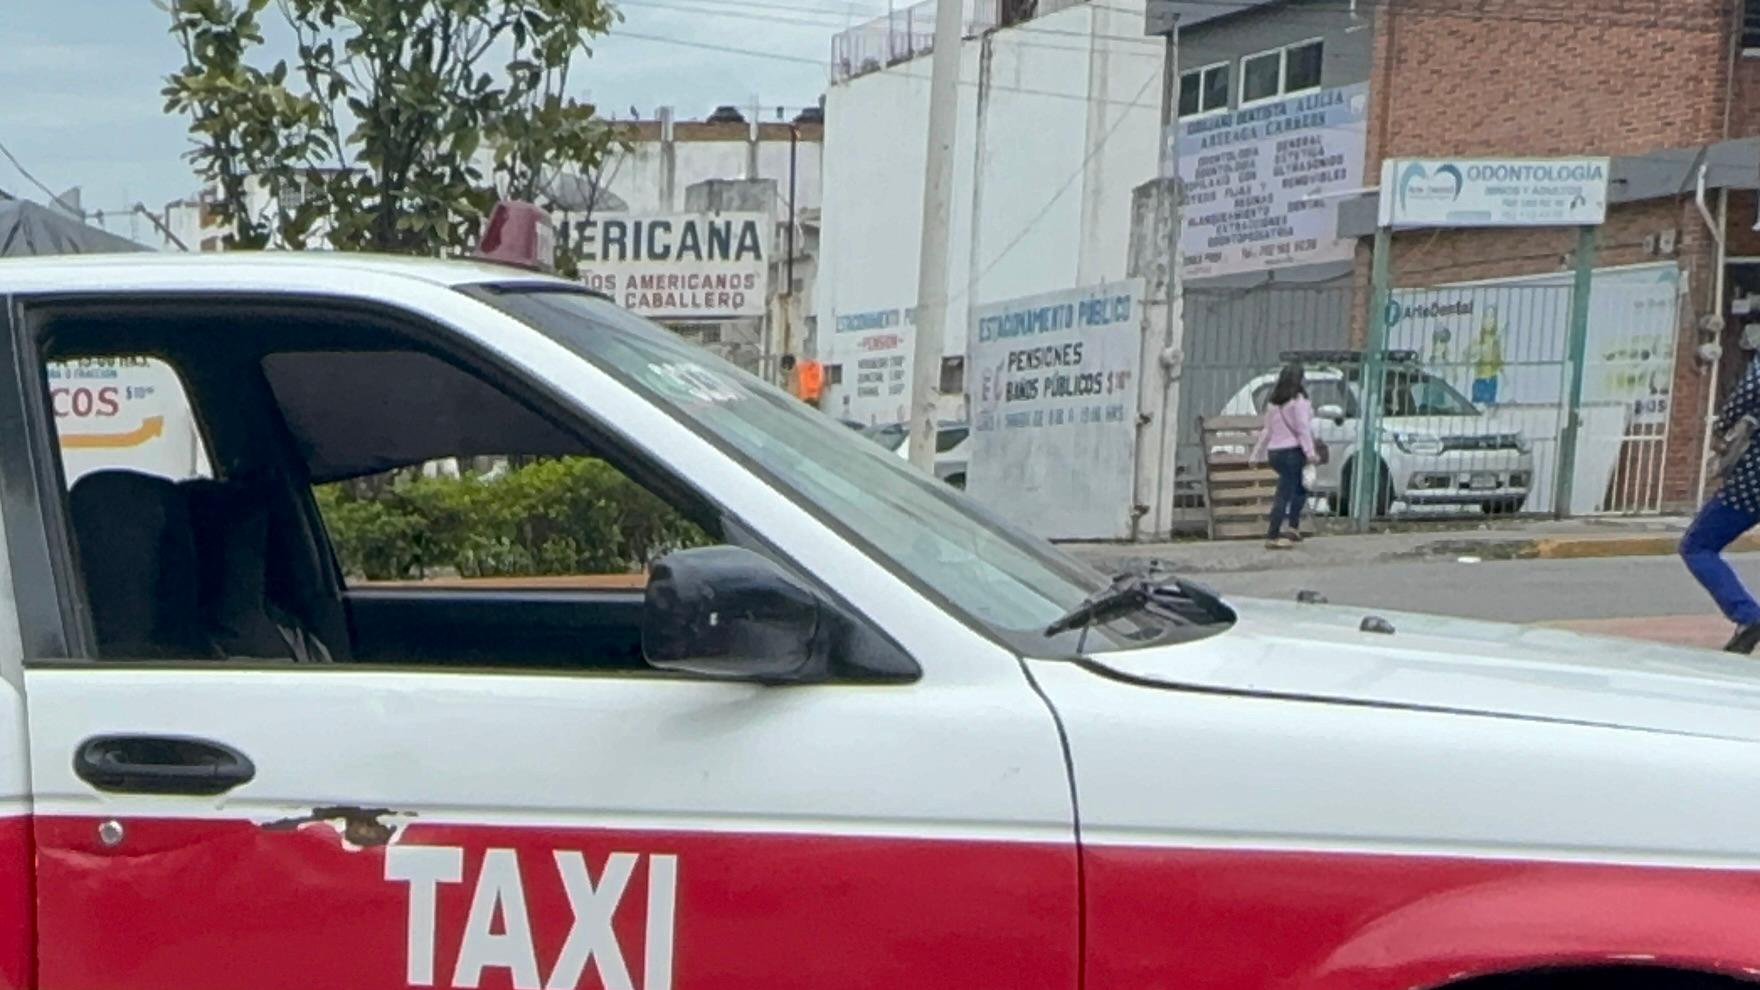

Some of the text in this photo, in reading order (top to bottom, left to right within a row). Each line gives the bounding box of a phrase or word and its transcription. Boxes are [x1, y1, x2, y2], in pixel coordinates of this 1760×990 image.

[1236, 102, 1288, 126] DENTISTA
[1296, 92, 1345, 113] ALICIA
[1200, 127, 1258, 149] ARTEAGA
[1466, 163, 1603, 182] ODONTOLOGÍA
[624, 273, 756, 291] AMERICANOS
[624, 290, 746, 311] CABALLERO
[1007, 341, 1084, 373] PENSIONES
